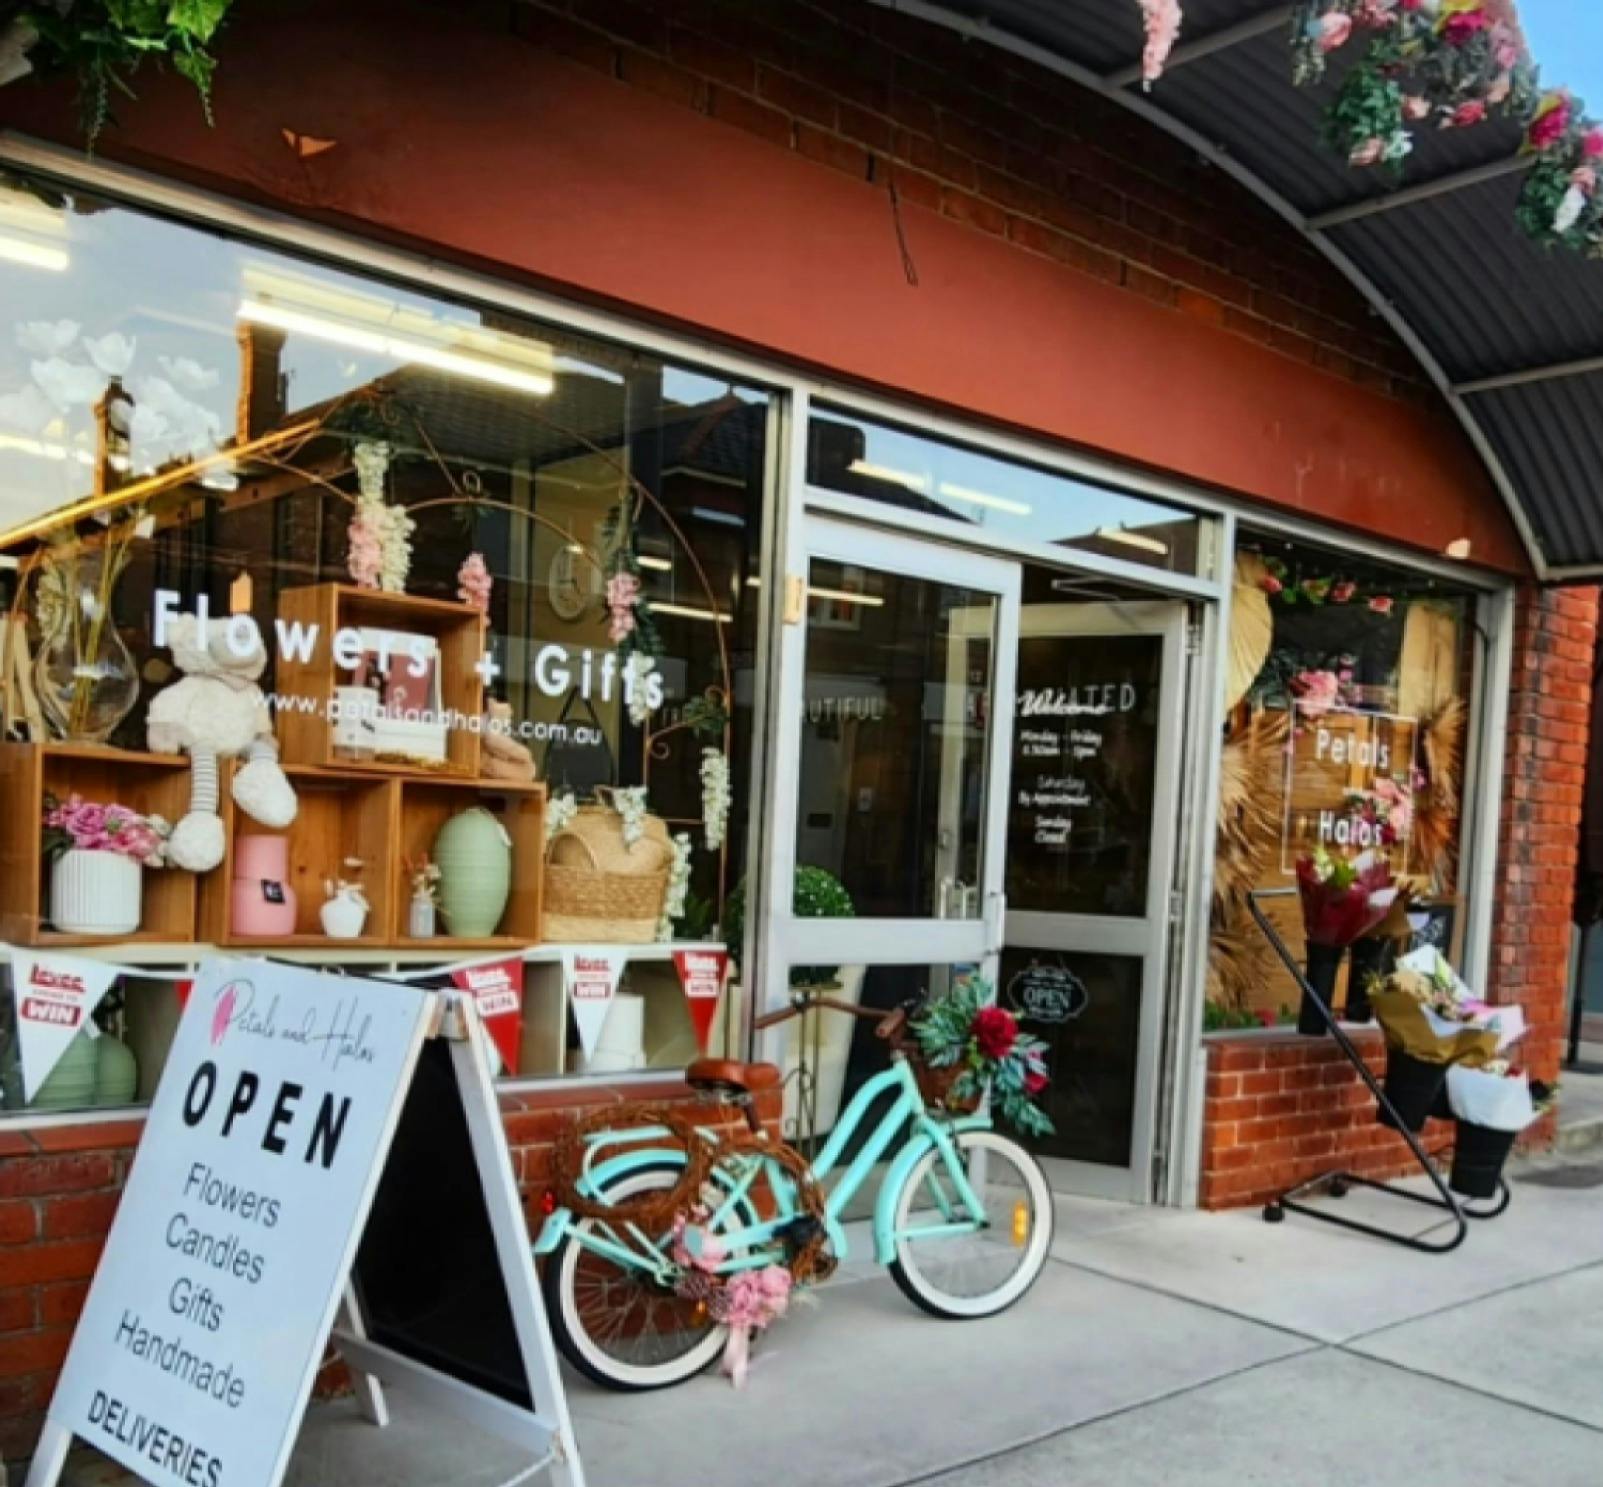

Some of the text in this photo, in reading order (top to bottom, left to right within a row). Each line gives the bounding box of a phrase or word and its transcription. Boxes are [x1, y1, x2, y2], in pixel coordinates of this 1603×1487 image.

[153, 589, 664, 710] Flowers + Gifts
[1316, 728, 1389, 770] Petals
[1319, 809, 1384, 847] Halos
[26, 1000, 76, 1024] WIN
[183, 1060, 352, 1169] OPEN
[184, 1162, 281, 1228] Flowers
[166, 1212, 265, 1284] Candles
[168, 1276, 224, 1332] Gifts
[115, 1309, 245, 1408] Handmade
[88, 1389, 223, 1487] DELIVERIES
